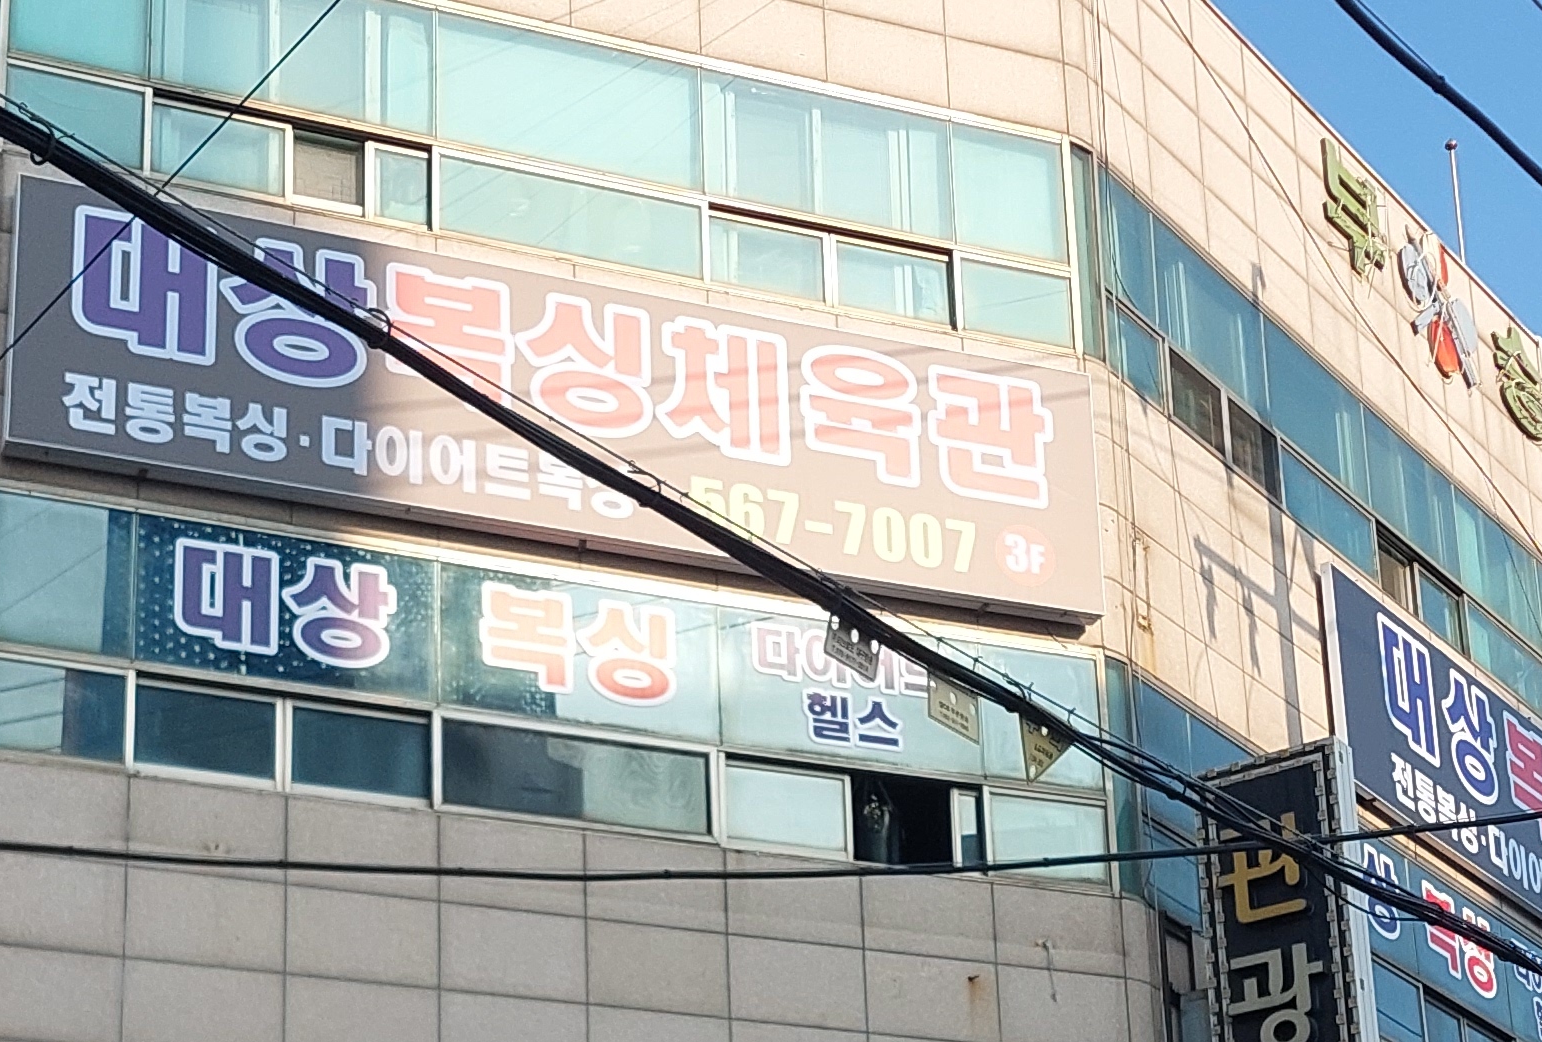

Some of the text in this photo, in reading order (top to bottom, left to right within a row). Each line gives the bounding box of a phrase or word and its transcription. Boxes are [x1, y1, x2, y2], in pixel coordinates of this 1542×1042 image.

[1005, 533, 1047, 575] 3F
[173, 538, 676, 706] 대상 복싱
[802, 685, 905, 753] 헬스
[1363, 843, 1402, 940] 상
